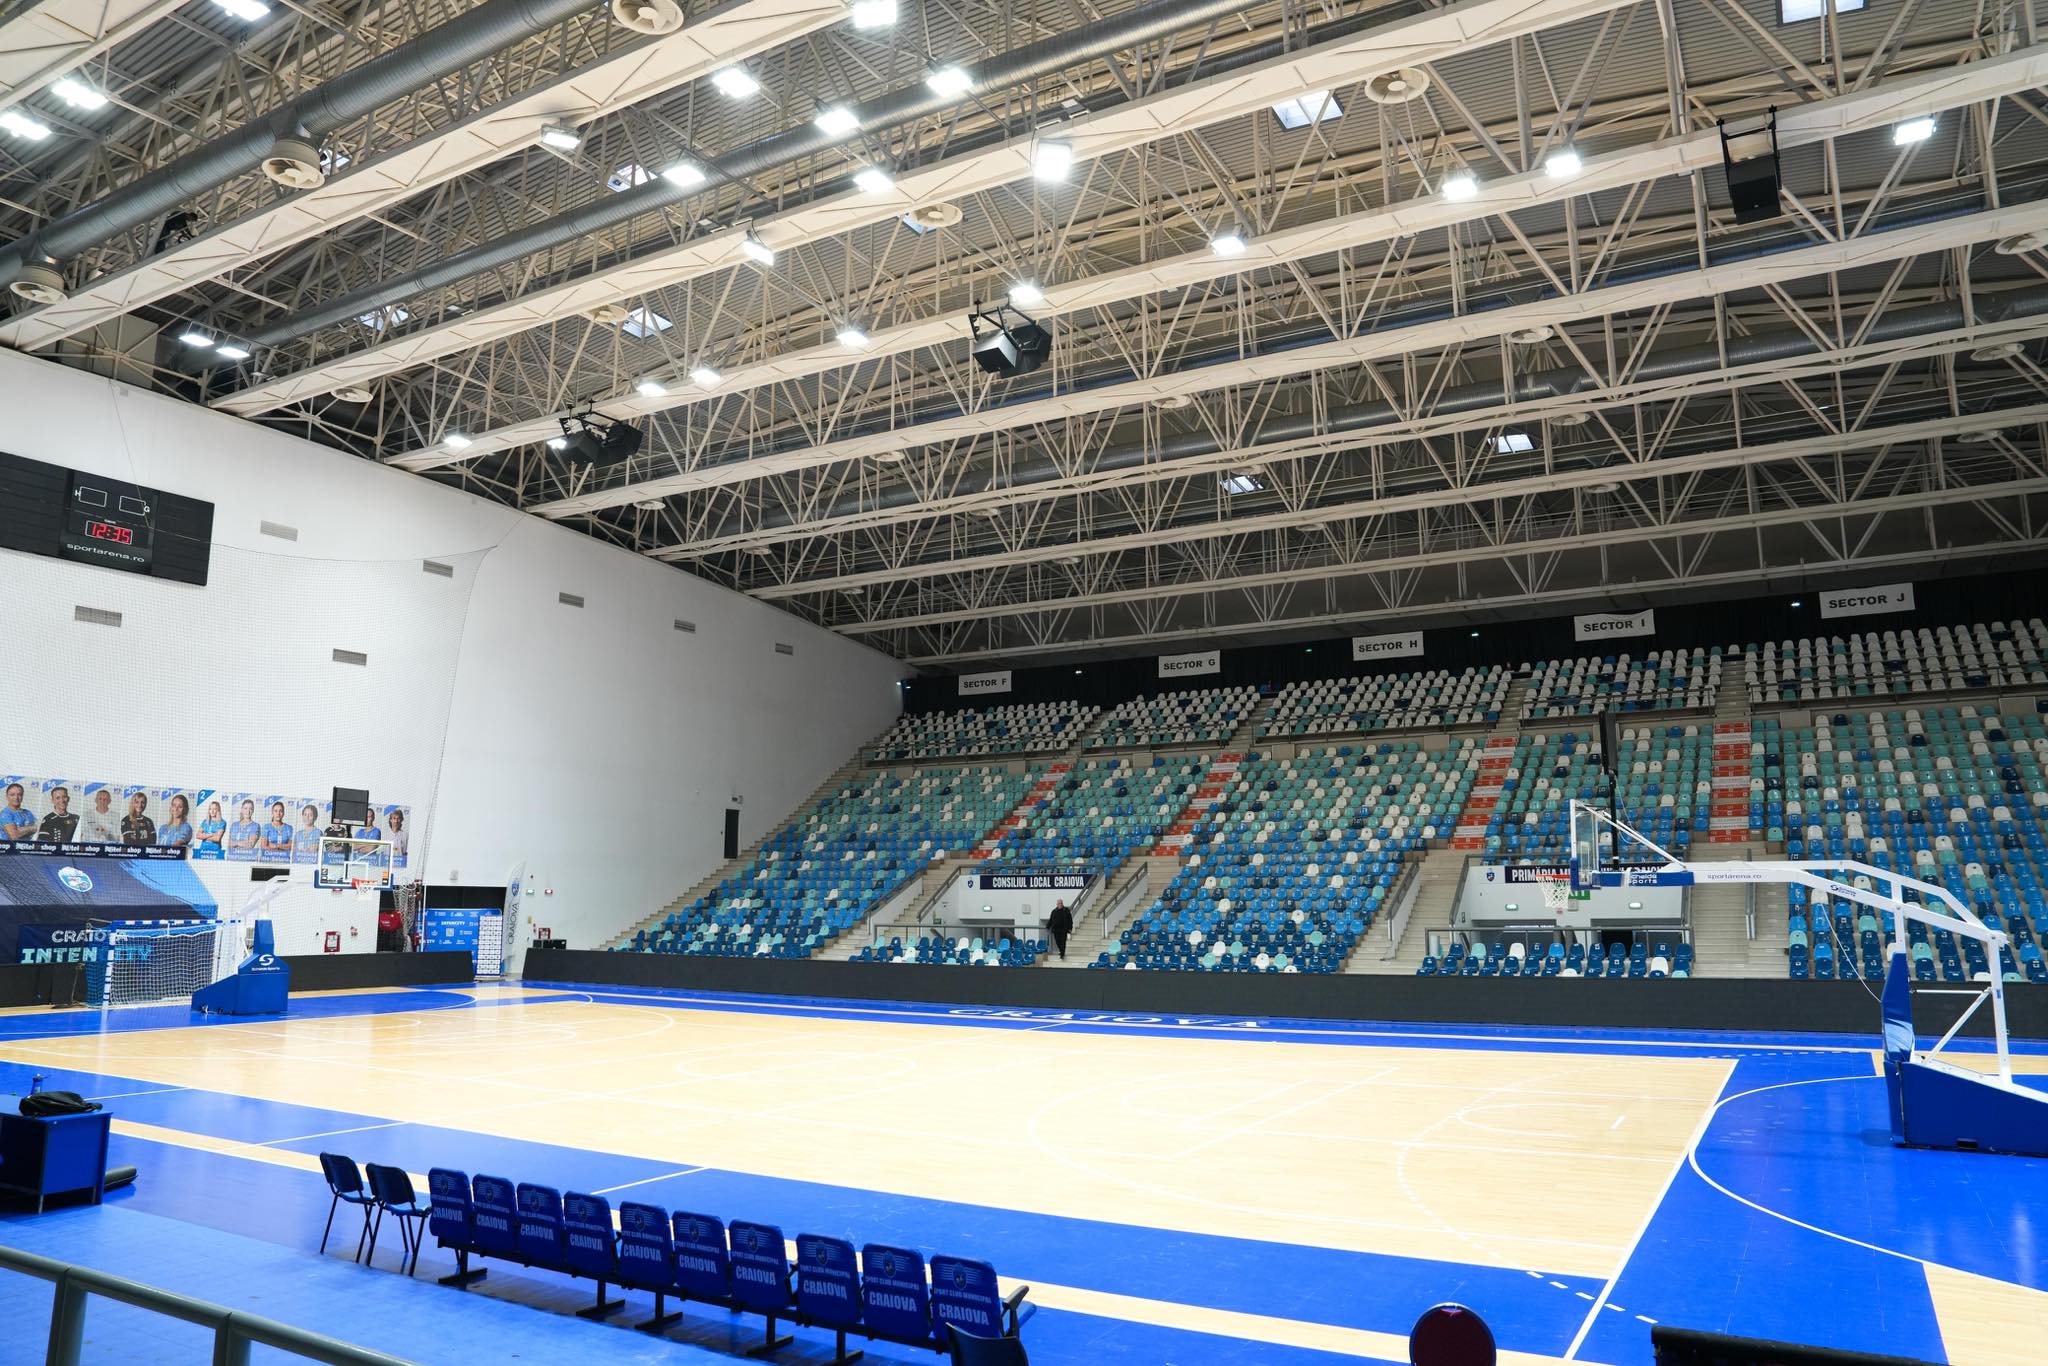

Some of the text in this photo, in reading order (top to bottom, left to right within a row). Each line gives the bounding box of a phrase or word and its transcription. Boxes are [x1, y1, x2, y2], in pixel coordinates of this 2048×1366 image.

[143, 505, 150, 513] G
[91, 523, 131, 543] 12:35
[66, 542, 145, 563] sportarena.ro
[1829, 592, 1905, 608] SECTOR J
[1583, 620, 1633, 632] SECTOR
[1358, 640, 1418, 652] SECTOR H
[1163, 658, 1216, 670] SECTOR G
[963, 679, 997, 688] SECTOR
[200, 791, 206, 799] 2
[992, 876, 1084, 888] CONSILIUL LOCAL CRAIOVA
[949, 1009, 1260, 1028] CRAIOVA
[520, 1223, 554, 1241] CRAIOVA
[569, 1233, 603, 1252] CRAIOVA
[623, 1243, 662, 1262] CRAIOVA
[679, 1254, 717, 1274] CRAIOVA
[735, 1265, 776, 1286] CRAIOVA
[803, 1279, 847, 1300] CRAIOVA
[869, 1291, 917, 1312] CRAIOVA
[938, 1303, 989, 1326] CRAIOVA
